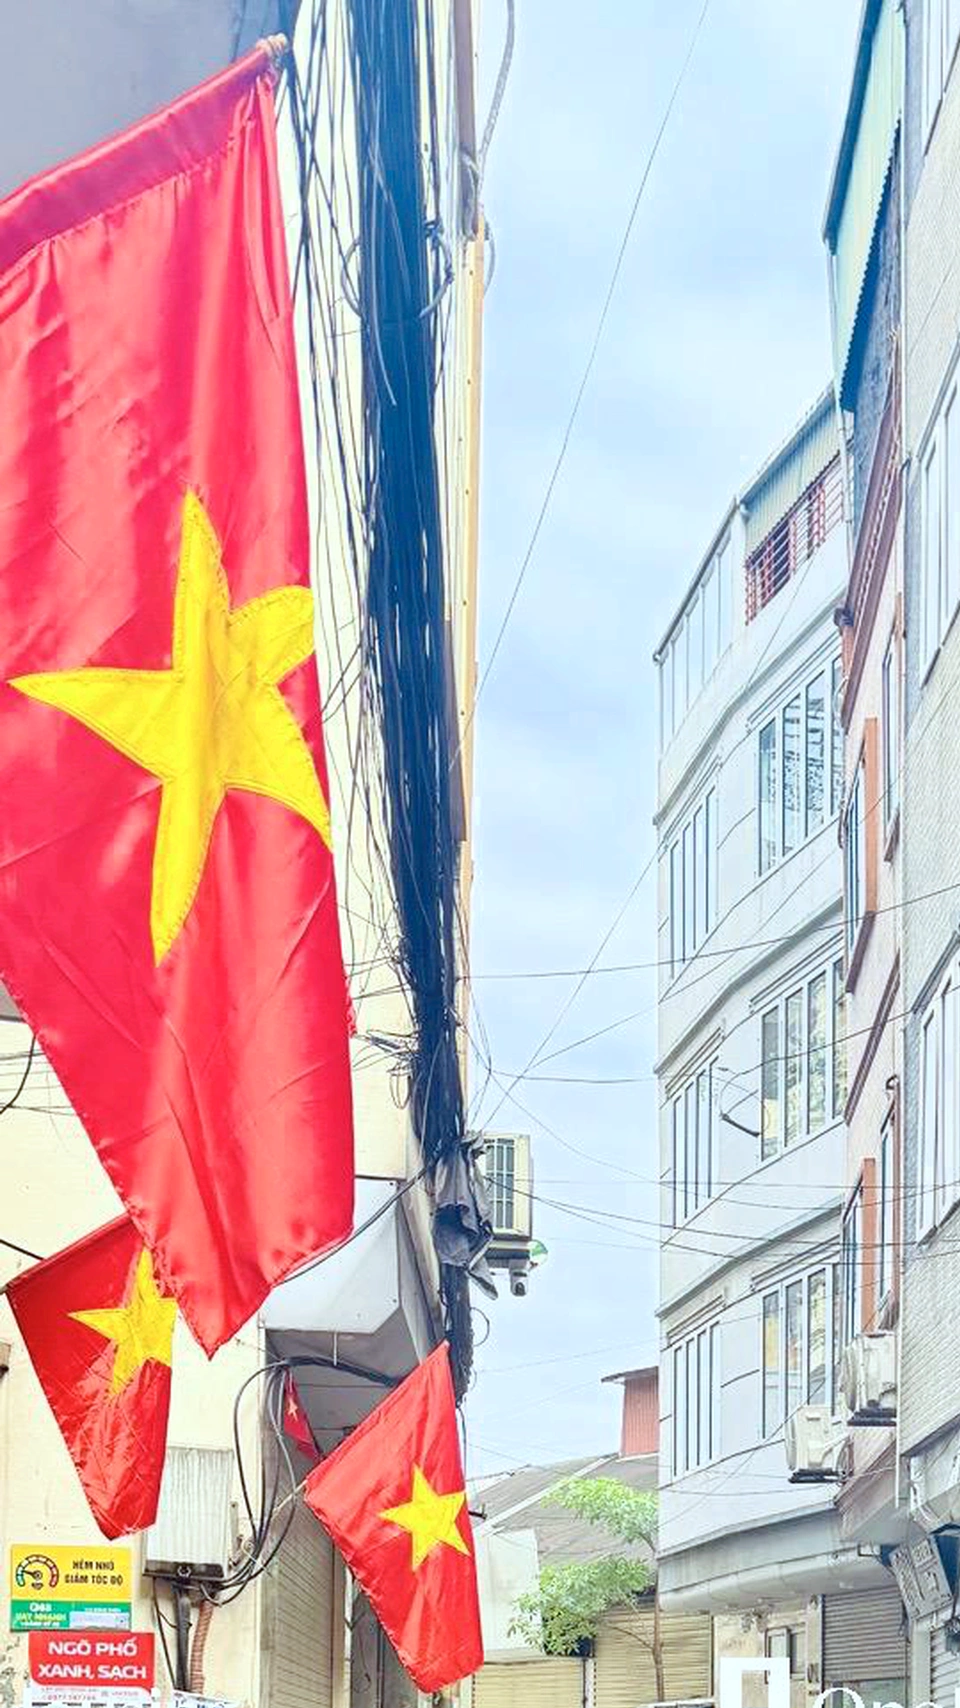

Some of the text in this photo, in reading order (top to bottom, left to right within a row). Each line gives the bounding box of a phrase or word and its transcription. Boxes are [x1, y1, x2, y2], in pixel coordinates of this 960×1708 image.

[95, 1636, 137, 1656] PHỐ
[38, 1664, 146, 1681] XANH, SẠCH
